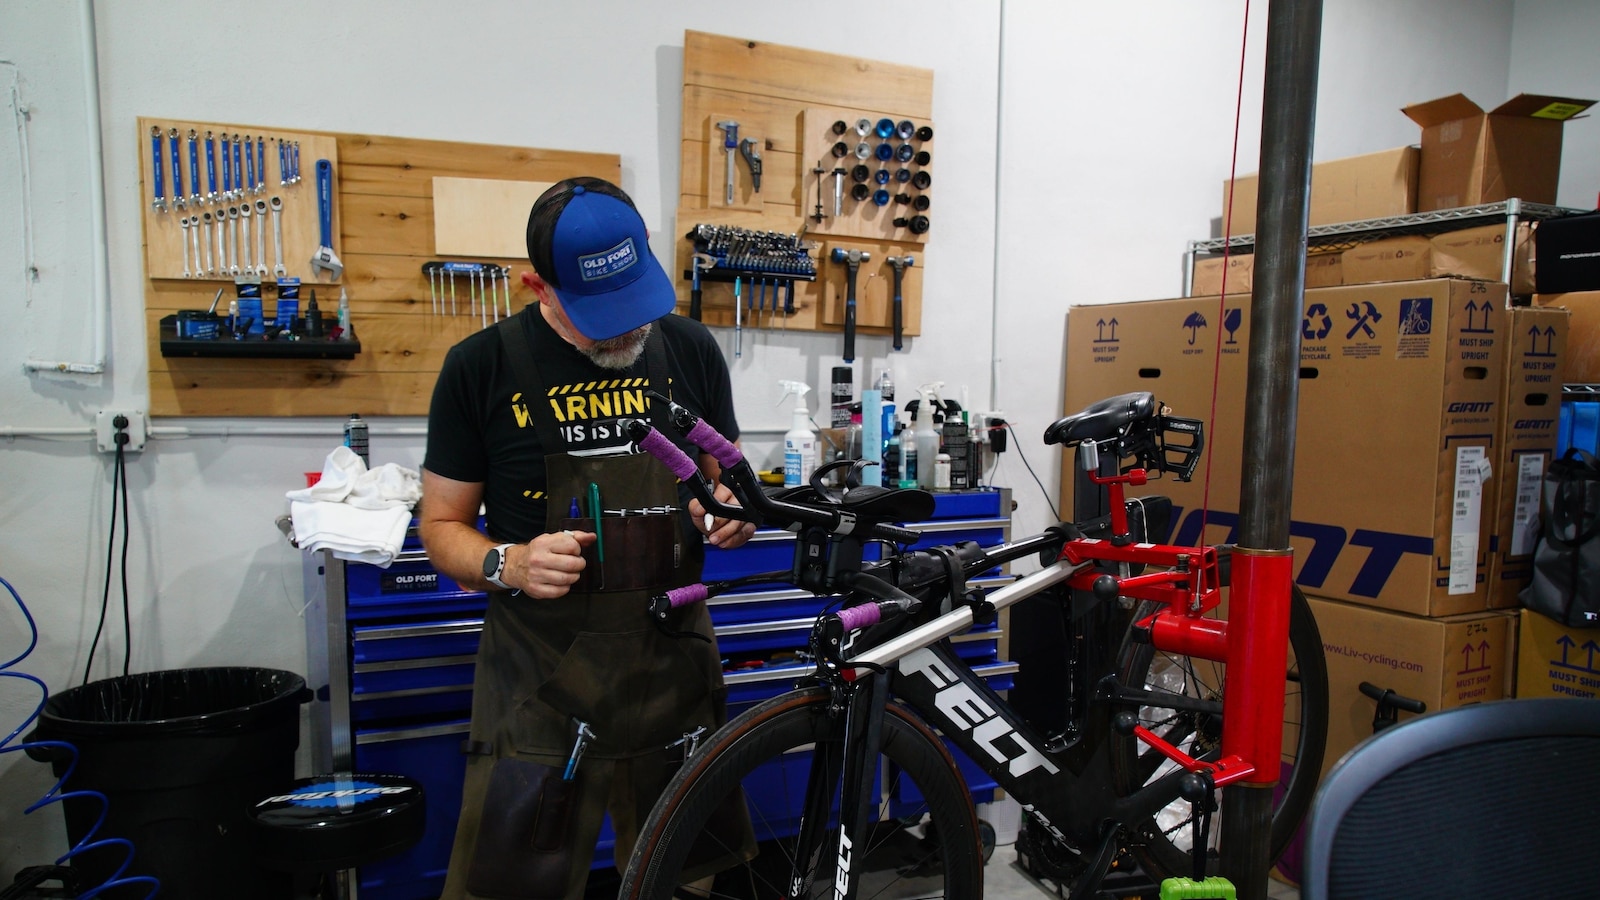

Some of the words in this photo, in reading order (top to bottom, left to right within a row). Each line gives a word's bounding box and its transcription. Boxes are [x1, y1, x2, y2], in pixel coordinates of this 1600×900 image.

[584, 257, 606, 269] OLD
[607, 244, 631, 264] FORT
[586, 266, 608, 277] BIKE
[612, 253, 633, 270] SHOP
[1459, 338, 1478, 347] MUST
[1479, 338, 1494, 347] SHIP
[1461, 352, 1489, 360] UPRIGHT
[1523, 362, 1541, 370] MUST
[1542, 362, 1556, 370] SHIP
[1525, 374, 1552, 383] UPRIGHT
[1447, 401, 1494, 413] GIANT
[1513, 419, 1555, 429] GIANT
[395, 575, 414, 583] OLD
[415, 574, 438, 582] FORT
[1324, 643, 1423, 673] ww.Liv-cycling.com
[1456, 677, 1475, 688] MUST
[1477, 674, 1491, 684] SHIP
[1549, 670, 1578, 683] MUST
[1459, 687, 1486, 700] UPRIGHT
[1552, 683, 1596, 699] UPRIGHT
[899, 647, 1060, 778] FELT
